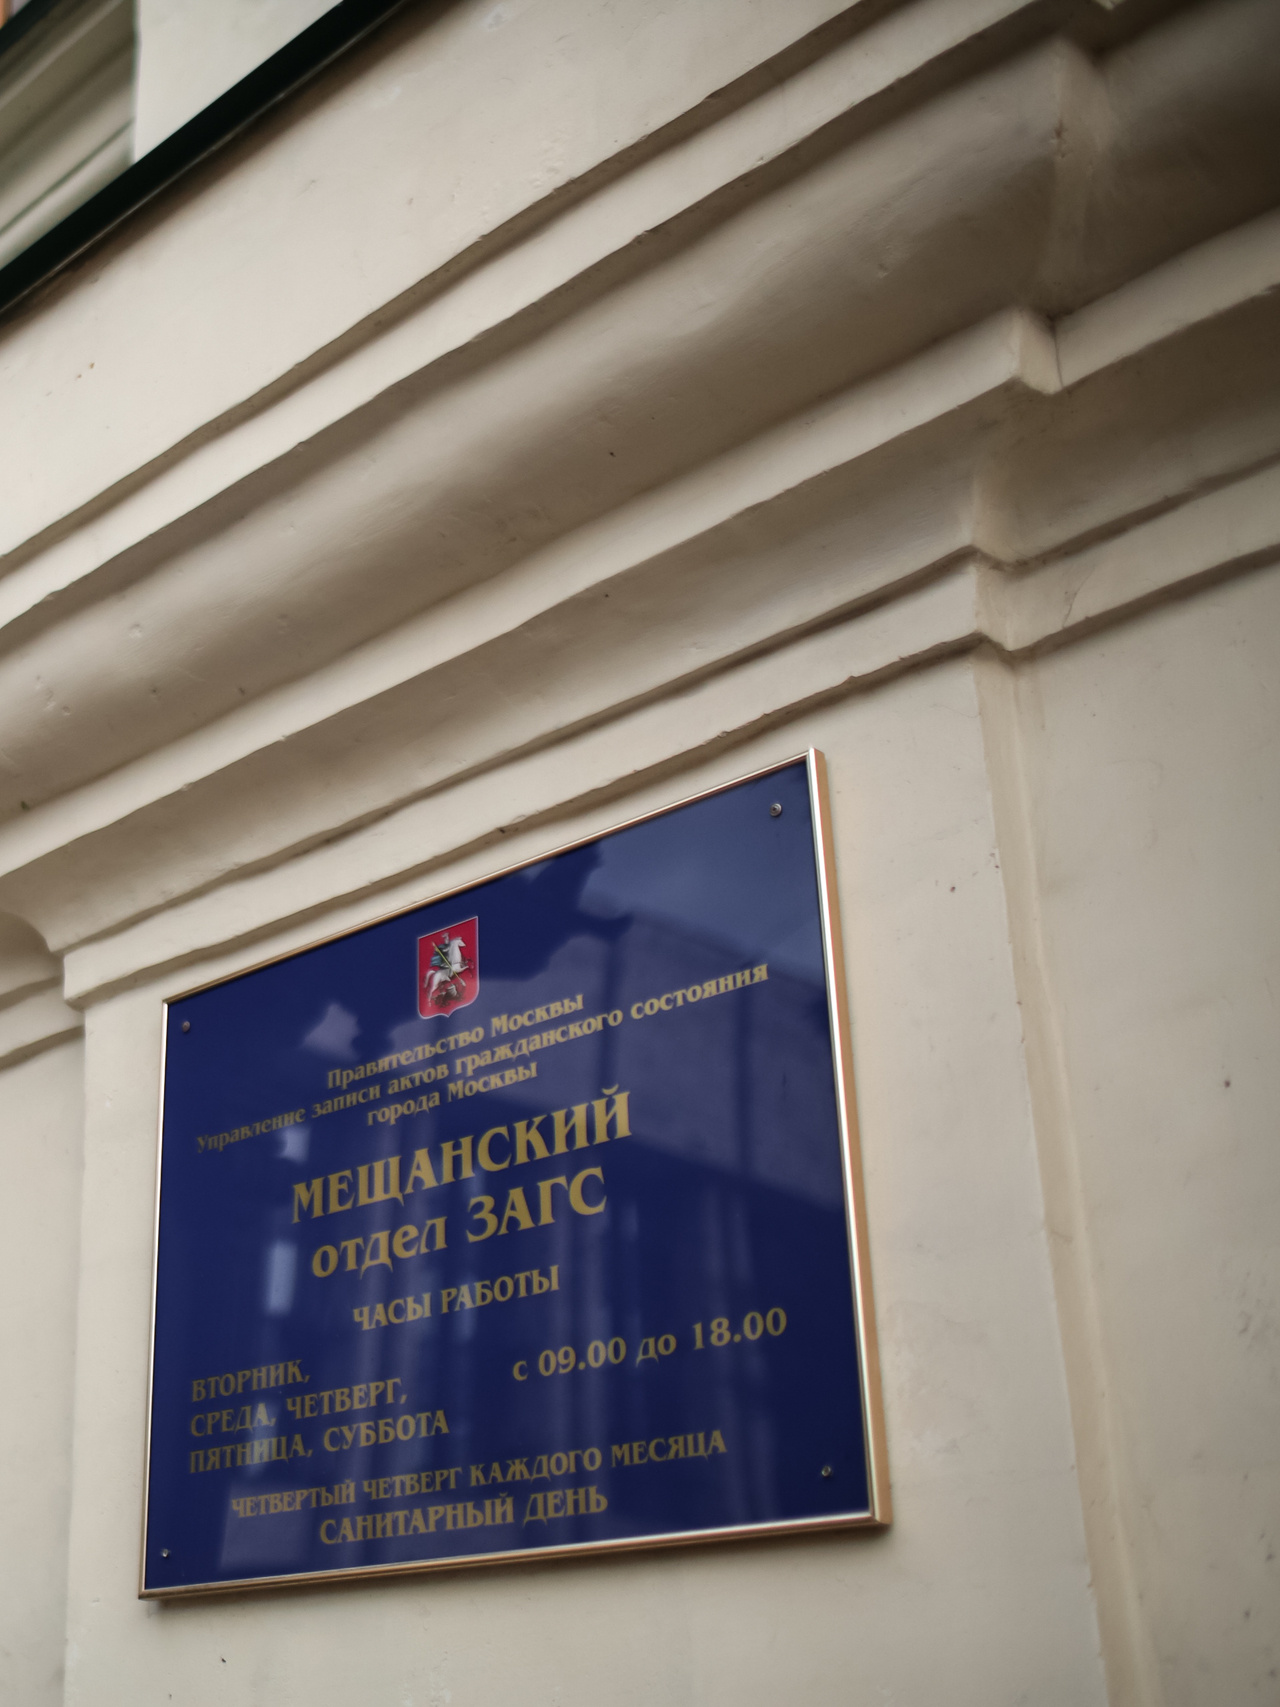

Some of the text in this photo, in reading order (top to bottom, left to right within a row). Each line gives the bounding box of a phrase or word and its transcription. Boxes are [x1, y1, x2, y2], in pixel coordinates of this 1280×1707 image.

[196, 963, 769, 1154] Управление записи актов гражданского состояния
[327, 994, 584, 1090] Правительство Москвы
[367, 1062, 538, 1128] города Москвы
[291, 1084, 632, 1224] МЕЩАНСКИЙ
[312, 1166, 607, 1279] отдел ЗАГС
[352, 1264, 560, 1332] ЧАСЫ РАБОТЫ
[513, 1307, 788, 1382] с 09.00 до 18.00
[190, 1377, 408, 1438] СРЕДА, ЧЕТВЕРГ,
[191, 1359, 311, 1403] ВТОРНИК,
[189, 1409, 450, 1474] ПЯТНИЦА, СУББОТА
[231, 1429, 727, 1520] ЧЕТВЕРТЫЙ ЧЕТВЕРГ КАЖДОГО МЕСЯЦА
[319, 1484, 609, 1545] САНИТАРНЫЙ ДЕНЬ
